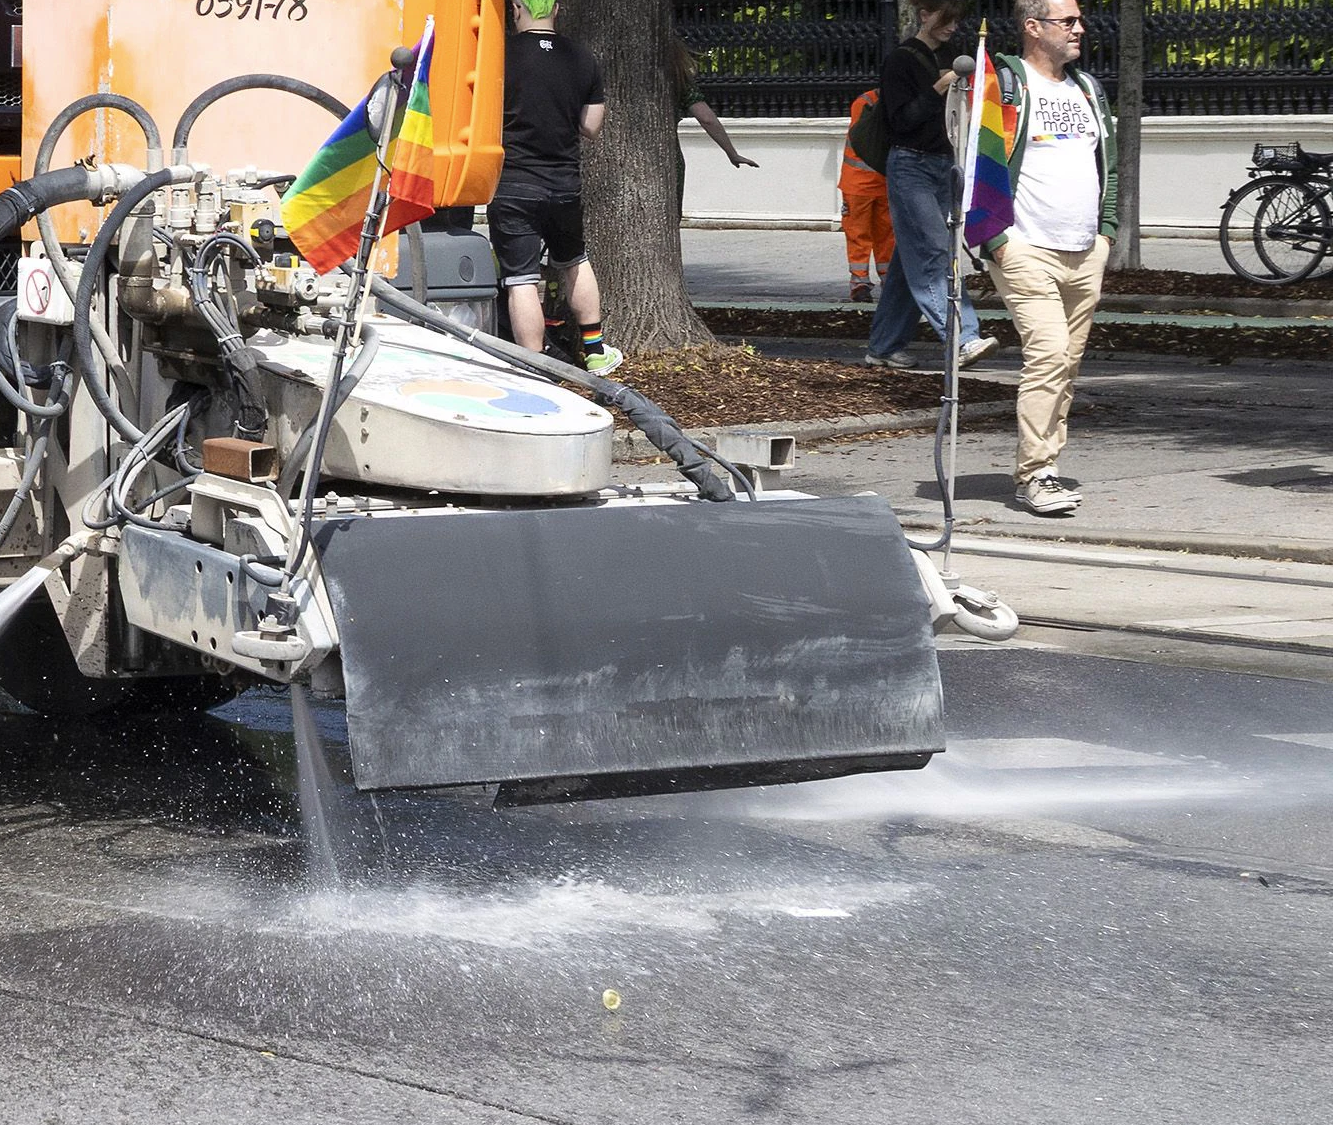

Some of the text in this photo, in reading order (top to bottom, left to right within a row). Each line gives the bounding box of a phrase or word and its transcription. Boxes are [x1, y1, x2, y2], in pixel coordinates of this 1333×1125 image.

[1039, 97, 1082, 113] Pride
[1035, 110, 1090, 123] means
[1043, 121, 1086, 134] more
